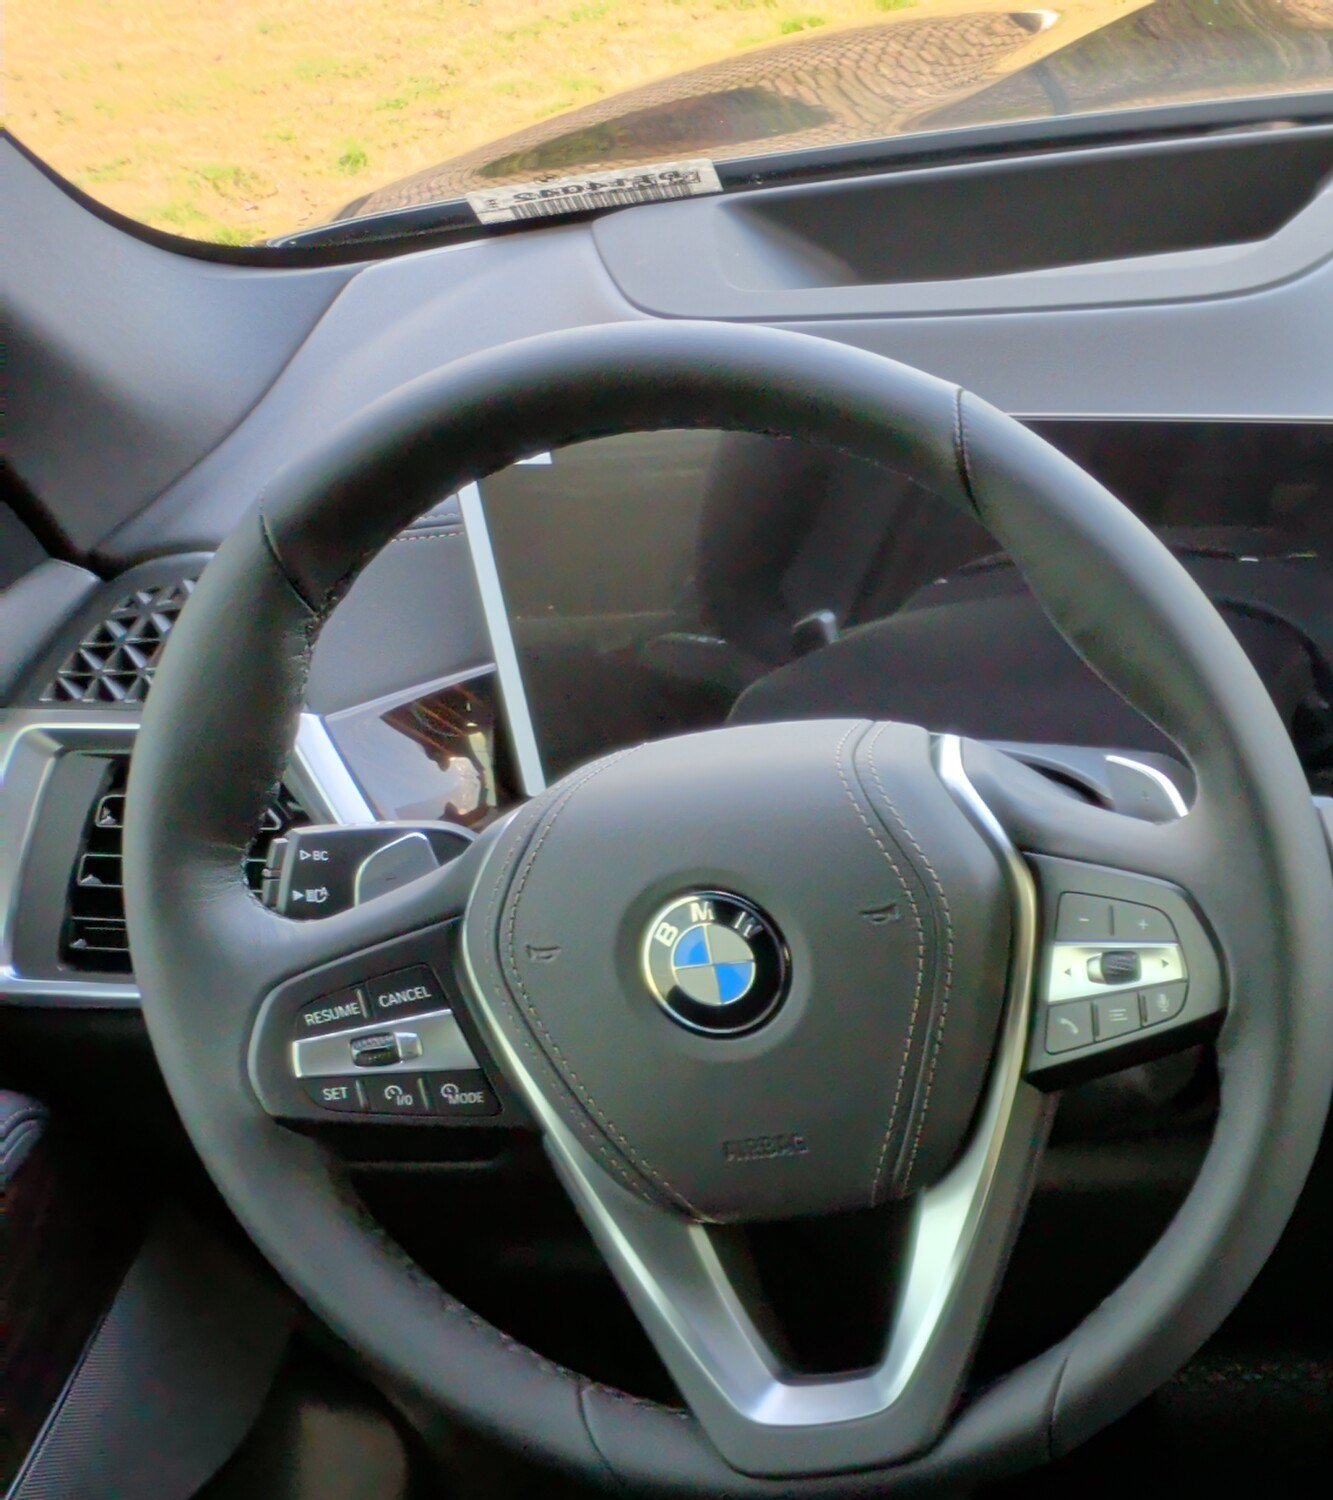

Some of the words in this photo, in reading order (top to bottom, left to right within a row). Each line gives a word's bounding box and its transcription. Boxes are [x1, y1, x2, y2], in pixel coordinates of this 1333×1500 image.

[654, 901, 763, 948] BMW
[378, 985, 432, 1008] CANCEL
[304, 1002, 361, 1026] RESUME
[323, 1086, 348, 1101] SET
[448, 1091, 485, 1105] MODE
